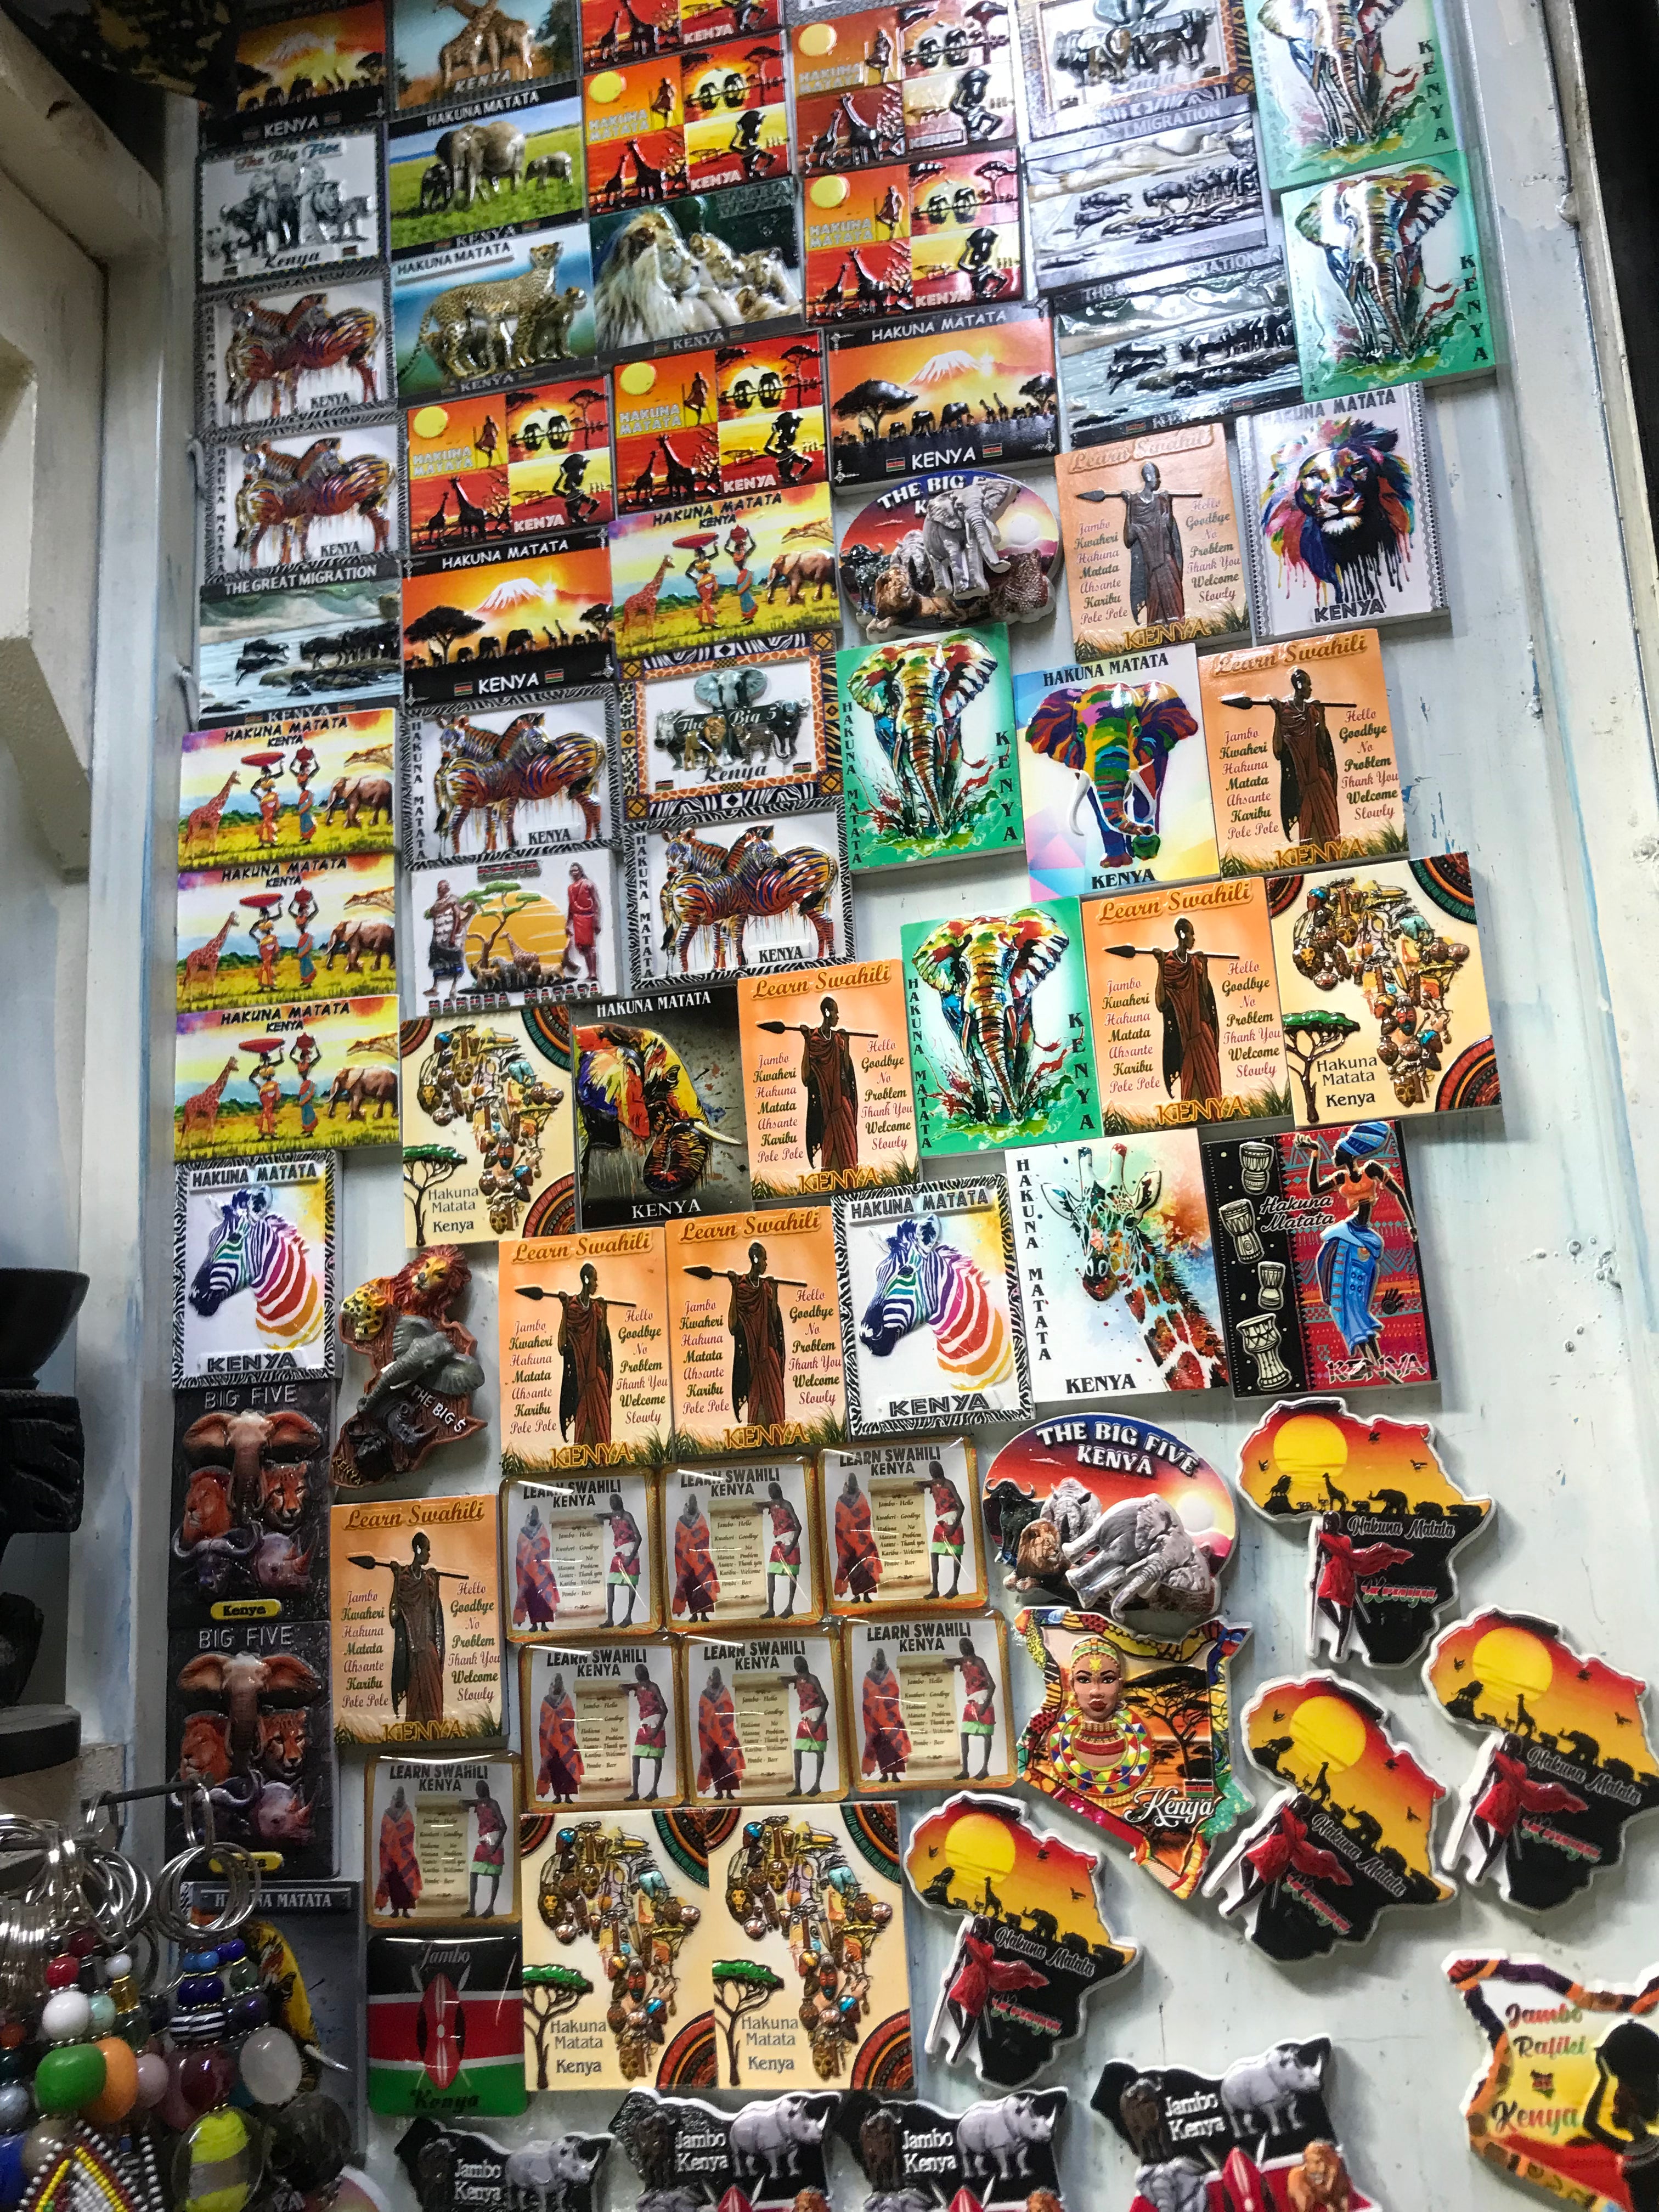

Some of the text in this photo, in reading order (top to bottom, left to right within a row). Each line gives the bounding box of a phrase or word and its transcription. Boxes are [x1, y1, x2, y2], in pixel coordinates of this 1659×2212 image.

[684, 24, 734, 44] KENYA
[479, 91, 539, 116] MATATA
[263, 115, 319, 139] KENYA
[691, 170, 742, 191] KENYA
[263, 250, 321, 269] Kenya
[397, 242, 511, 274] HAKUNA MATATA
[872, 311, 1007, 341] HAKUNA MATATA
[673, 332, 725, 351] KENYA
[912, 447, 977, 470] KENYA
[877, 474, 967, 511] THE BIG
[653, 492, 782, 527] HAKUNA MATATA
[698, 512, 737, 530] KENYA
[442, 540, 569, 570] HAKUNA MATATA
[225, 565, 377, 595] THE GREAT MIGRATION
[1314, 599, 1385, 623] KENYA
[1216, 634, 1368, 675] Learn Swahili
[1043, 653, 1170, 686] HAKUNA MATATA
[478, 672, 539, 695] KENYA
[728, 708, 761, 725] Big
[766, 706, 777, 721] 5
[1346, 709, 1376, 723] Hello
[225, 716, 348, 743] HAKUNA MATATA
[1224, 729, 1260, 746] Jambo
[1339, 724, 1387, 743] Goodbye
[267, 734, 304, 747] KENYA
[1220, 742, 1268, 759] Kwaheri
[1357, 741, 1374, 754] No
[696, 764, 768, 785] Kenya
[1222, 760, 1268, 776] Hakuna
[1344, 757, 1392, 772] Problem
[842, 701, 862, 864] HAKUNA MATATA
[995, 731, 1018, 842] KENYA
[1226, 776, 1268, 791] Matata
[1341, 770, 1400, 789] Thank You
[1227, 792, 1271, 806] Ahsante
[1346, 789, 1398, 804] Welcome
[1231, 806, 1272, 823] Karibu
[1354, 804, 1395, 821] Slowly
[528, 827, 571, 844] KENYA
[1228, 821, 1279, 840] Pole Pole
[1274, 839, 1368, 870] KENYA
[636, 834, 650, 901] HAKUNA
[1091, 868, 1156, 890] KENYA
[1099, 882, 1251, 922] Learn Swahili
[758, 946, 804, 962] KENYA
[753, 965, 891, 999] Learn Swahili
[596, 991, 711, 1018] HAKUNA MATATA
[909, 978, 932, 1149] HAKUNA MATATA
[1069, 1012, 1095, 1130] KENYA
[1317, 1057, 1378, 1072] Hakuna
[1322, 1070, 1375, 1086] Matata
[1156, 1096, 1250, 1125] KENYA
[1326, 1092, 1376, 1108] Kenya
[193, 1163, 317, 1187] HAKUNA MATATA
[798, 1167, 881, 1194] KENYA
[428, 1188, 479, 1200] Hakuna
[851, 1188, 989, 1219] HAKUNA MATATA
[431, 1200, 476, 1214] Matata
[631, 1199, 702, 1219] KENYA
[1260, 1196, 1332, 1215] Hakuna
[433, 1219, 475, 1234] Kenya
[681, 1212, 820, 1242] Learn Swahili
[1261, 1213, 1335, 1232] Matata
[512, 1235, 650, 1261] Learn Swahili
[1016, 1159, 1052, 1361] HAKUNA MATATA
[207, 1352, 297, 1372] KENYA
[1325, 1353, 1427, 1384] KENYA
[1065, 1374, 1136, 1394] KENYA
[205, 1385, 298, 1409] BIG FIVE
[411, 1384, 437, 1408] THE
[432, 1402, 455, 1425] BIG
[889, 1392, 990, 1417] KENYA
[550, 1443, 634, 1468] KENYA
[840, 1446, 940, 1466] LEARN SWAHILI
[1036, 1422, 1201, 1477] THE BIG FIVE
[1077, 1444, 1154, 1476] KENYA
[871, 1461, 915, 1476] KENYA
[347, 1504, 484, 1528] Learn Swahili
[1347, 1516, 1455, 1539] Hakuna Matata
[223, 1602, 267, 1617] Kenya
[199, 1626, 292, 1647] BIG FIVE
[867, 1622, 971, 1641] LEARN SWAHILI
[900, 1638, 945, 1652] KENYA
[382, 1722, 464, 1742] KENYA
[390, 1763, 489, 1780] LEARN SWAHILI
[419, 1778, 462, 1792] KENYA
[1125, 1787, 1215, 1827] Kenya
[995, 1926, 1096, 1977] Hakuna Matata
[551, 2019, 607, 2033] Hakuna
[741, 2016, 798, 2029] Hakuna
[1505, 2003, 1583, 2029] Jambo
[554, 2035, 603, 2049] Matata
[747, 2032, 795, 2046] Matata
[1514, 2035, 1587, 2059] Rafiki
[556, 2059, 602, 2076] Kenya
[748, 2057, 794, 2072] Kenya
[1165, 2091, 1218, 2117] Jambo
[1169, 2116, 1225, 2141] Kenya
[1491, 2101, 1578, 2136] Kenya
[675, 2131, 726, 2149] Jambo
[902, 2129, 953, 2150] Jambo
[676, 2152, 729, 2172] Kenya
[903, 2154, 956, 2175] Kenya
